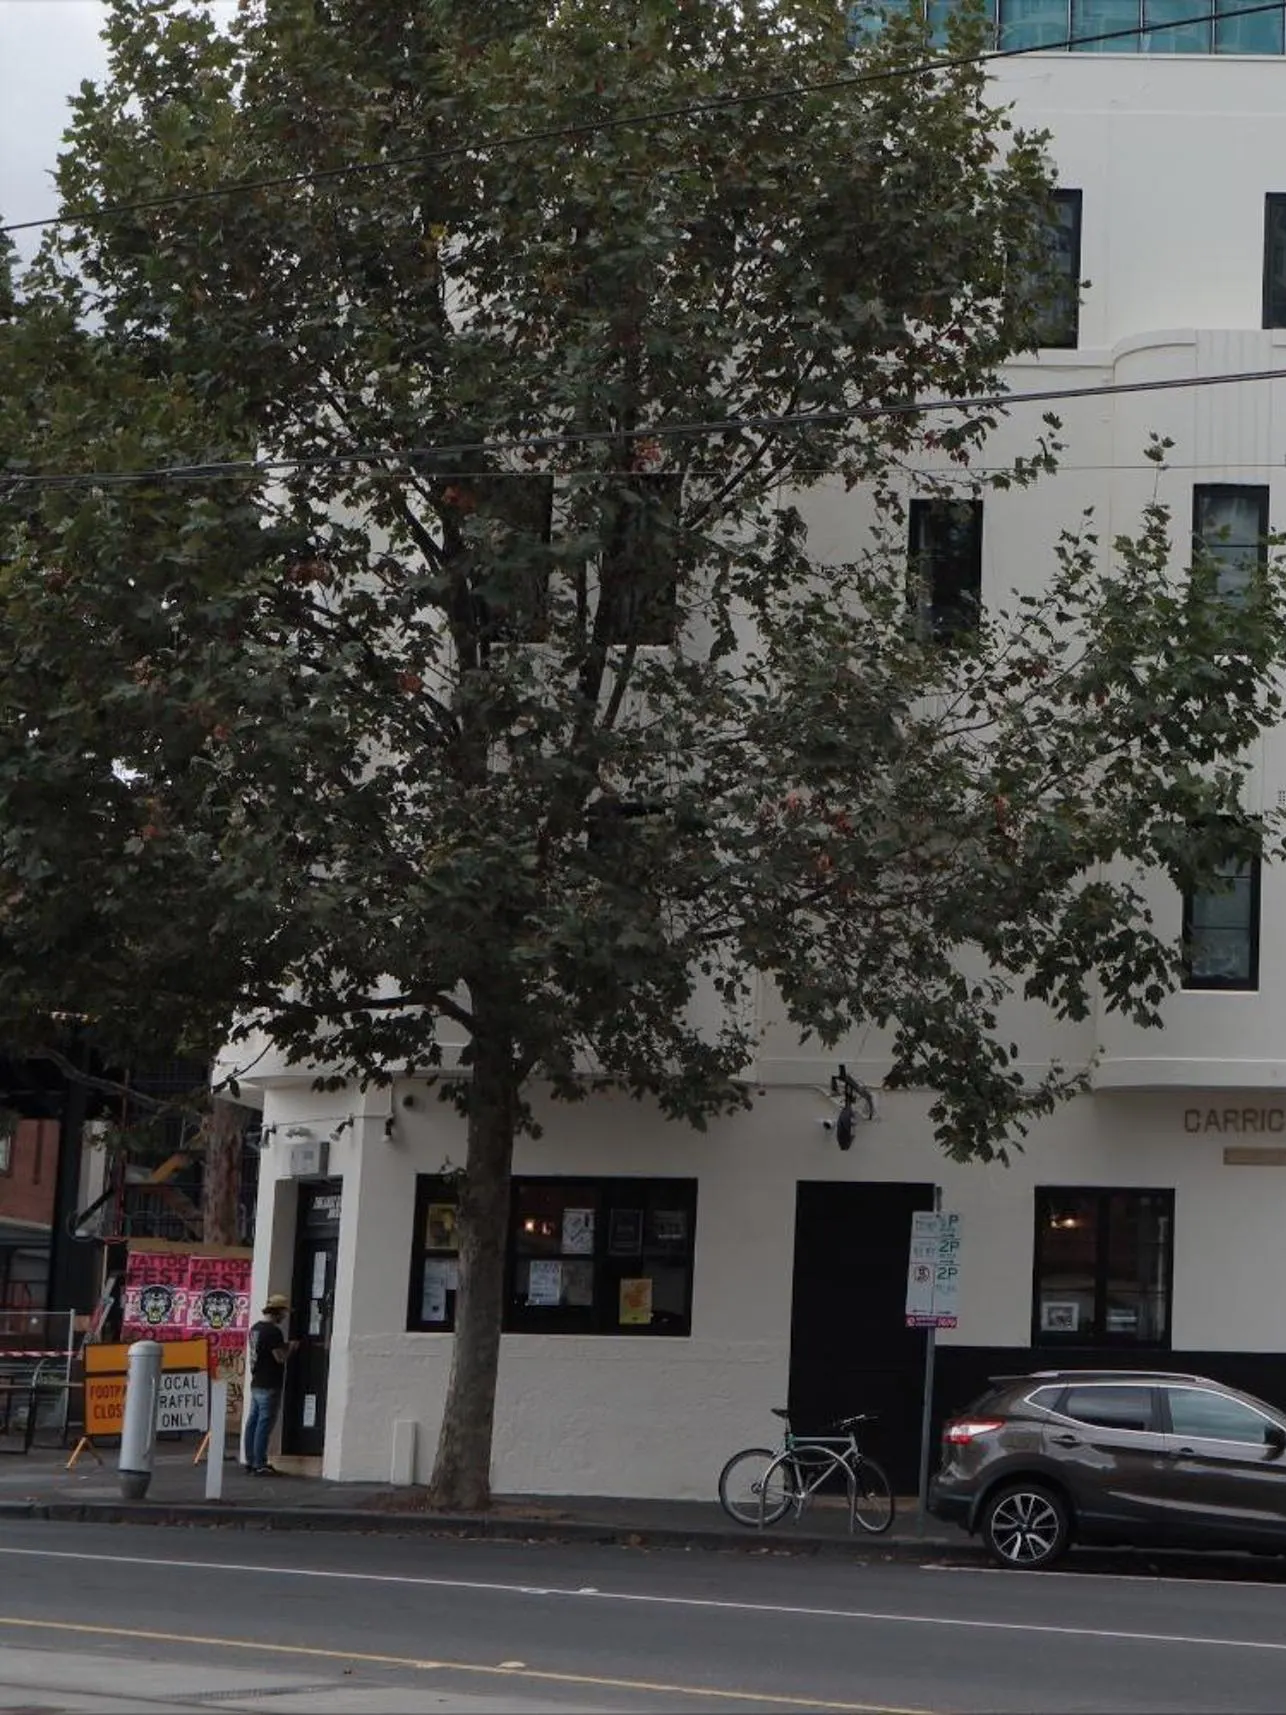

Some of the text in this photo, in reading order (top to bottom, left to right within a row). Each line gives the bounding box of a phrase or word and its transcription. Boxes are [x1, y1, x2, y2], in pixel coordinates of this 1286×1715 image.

[1184, 1108, 1285, 1134] CARRIC
[130, 1254, 188, 1269] TATTOO
[191, 1258, 250, 1272] TATTOO
[128, 1268, 188, 1286] FEST
[189, 1271, 250, 1290] FEST
[159, 1393, 204, 1409] RAFFIC
[93, 1404, 123, 1419] CLOS
[161, 1412, 195, 1428] ONLY
